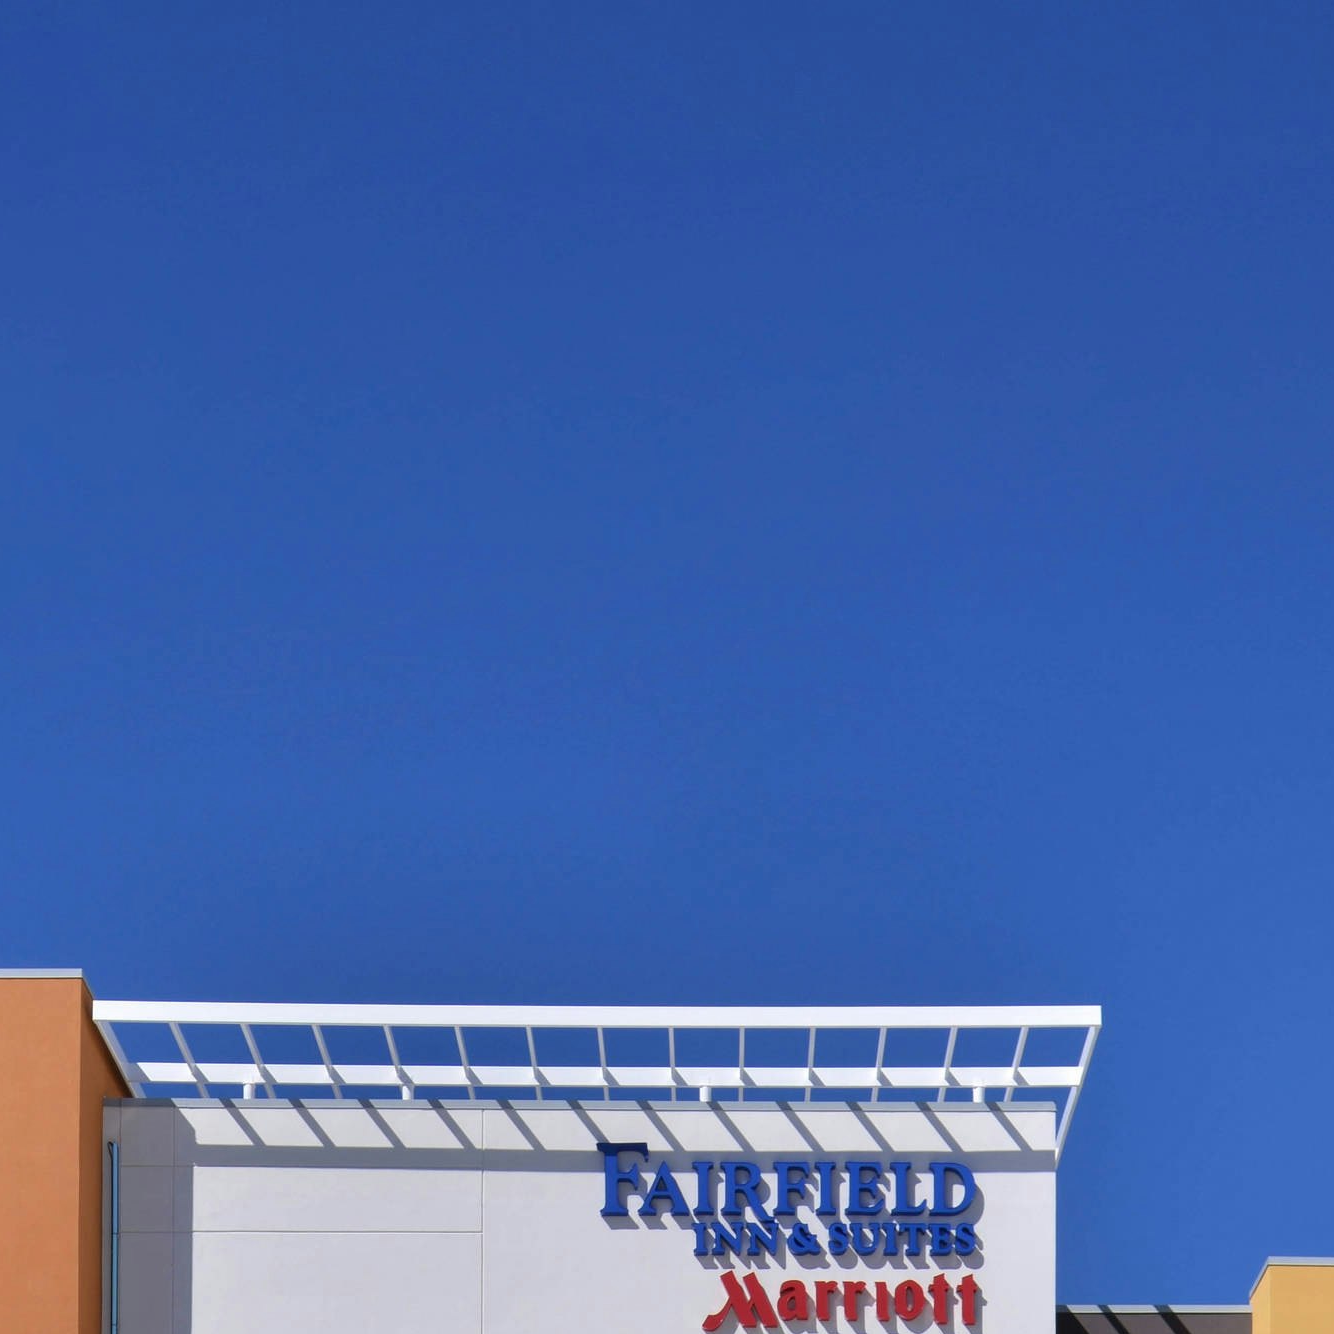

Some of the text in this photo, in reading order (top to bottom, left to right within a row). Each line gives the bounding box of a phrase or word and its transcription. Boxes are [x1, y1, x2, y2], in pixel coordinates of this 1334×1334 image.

[596, 1142, 976, 1222] FAIRFIELD
[693, 1222, 977, 1257] INN & SUITES
[701, 1270, 979, 1333] Marriott
